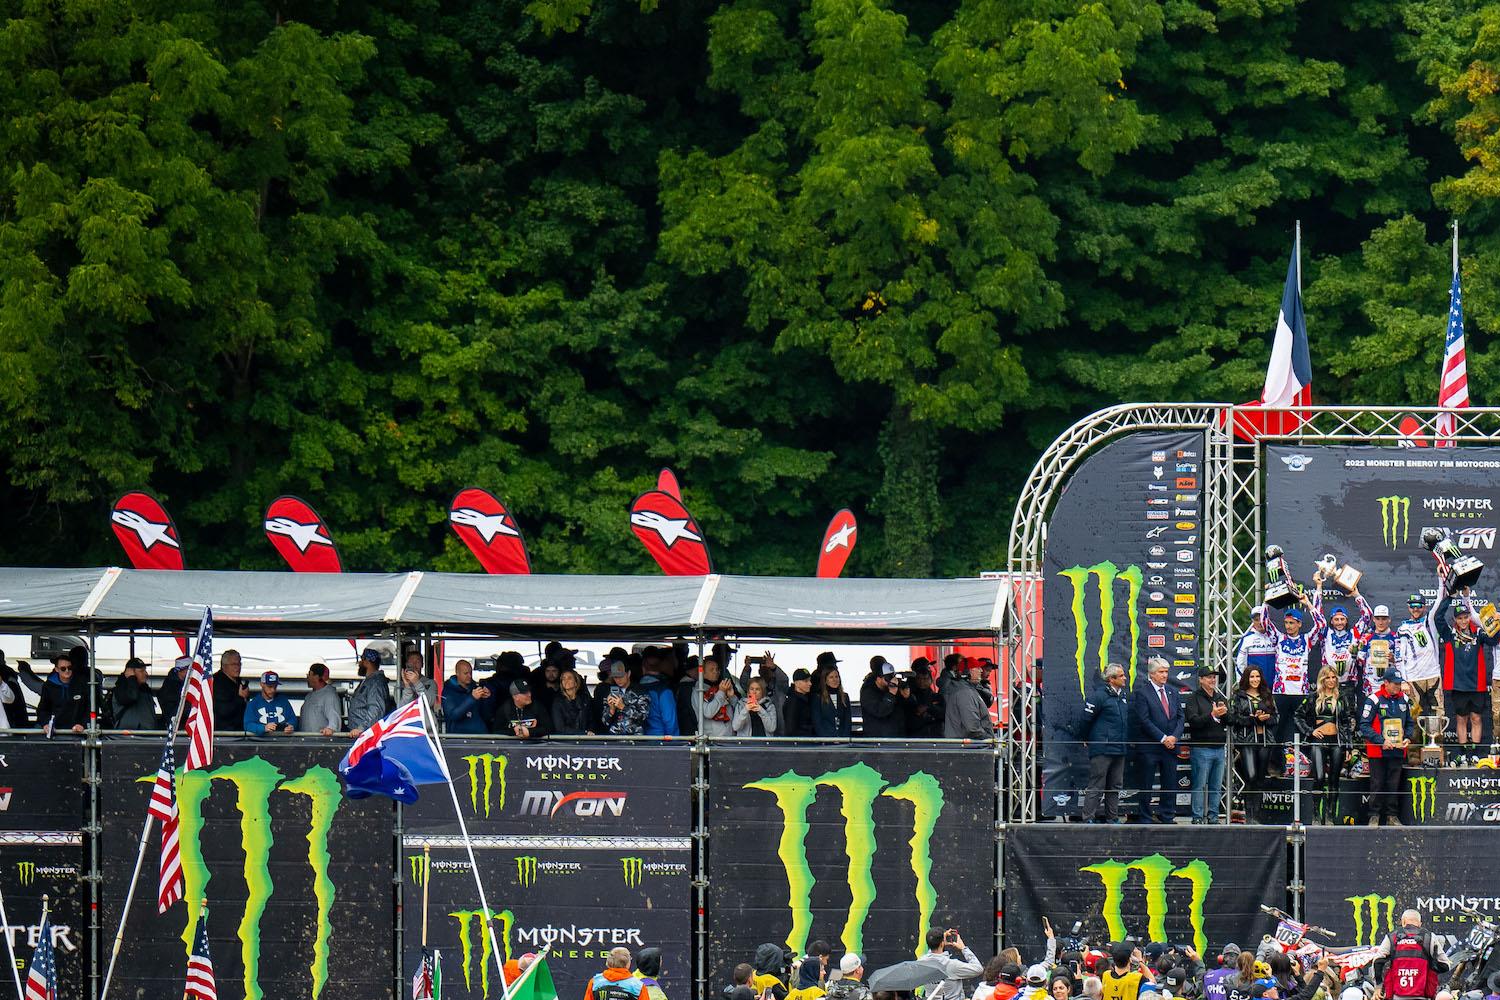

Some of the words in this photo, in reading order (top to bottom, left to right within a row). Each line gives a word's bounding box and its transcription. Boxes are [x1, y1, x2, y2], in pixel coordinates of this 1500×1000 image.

[1366, 460, 1405, 468] MONSTER
[1406, 460, 1438, 468] ENERGY
[1440, 460, 1454, 468] FIM
[1423, 496, 1493, 511] MONSTER
[526, 754, 622, 771] MONSTER
[36, 866, 76, 874] MONSTER
[537, 862, 581, 870] MONSTER
[643, 863, 687, 871] MONSTER
[518, 924, 644, 947] MONSTER
[1277, 928, 1299, 944] 103
[1470, 929, 1491, 945] 101
[1398, 969, 1418, 977] STAFF
[1400, 976, 1414, 987] 61
